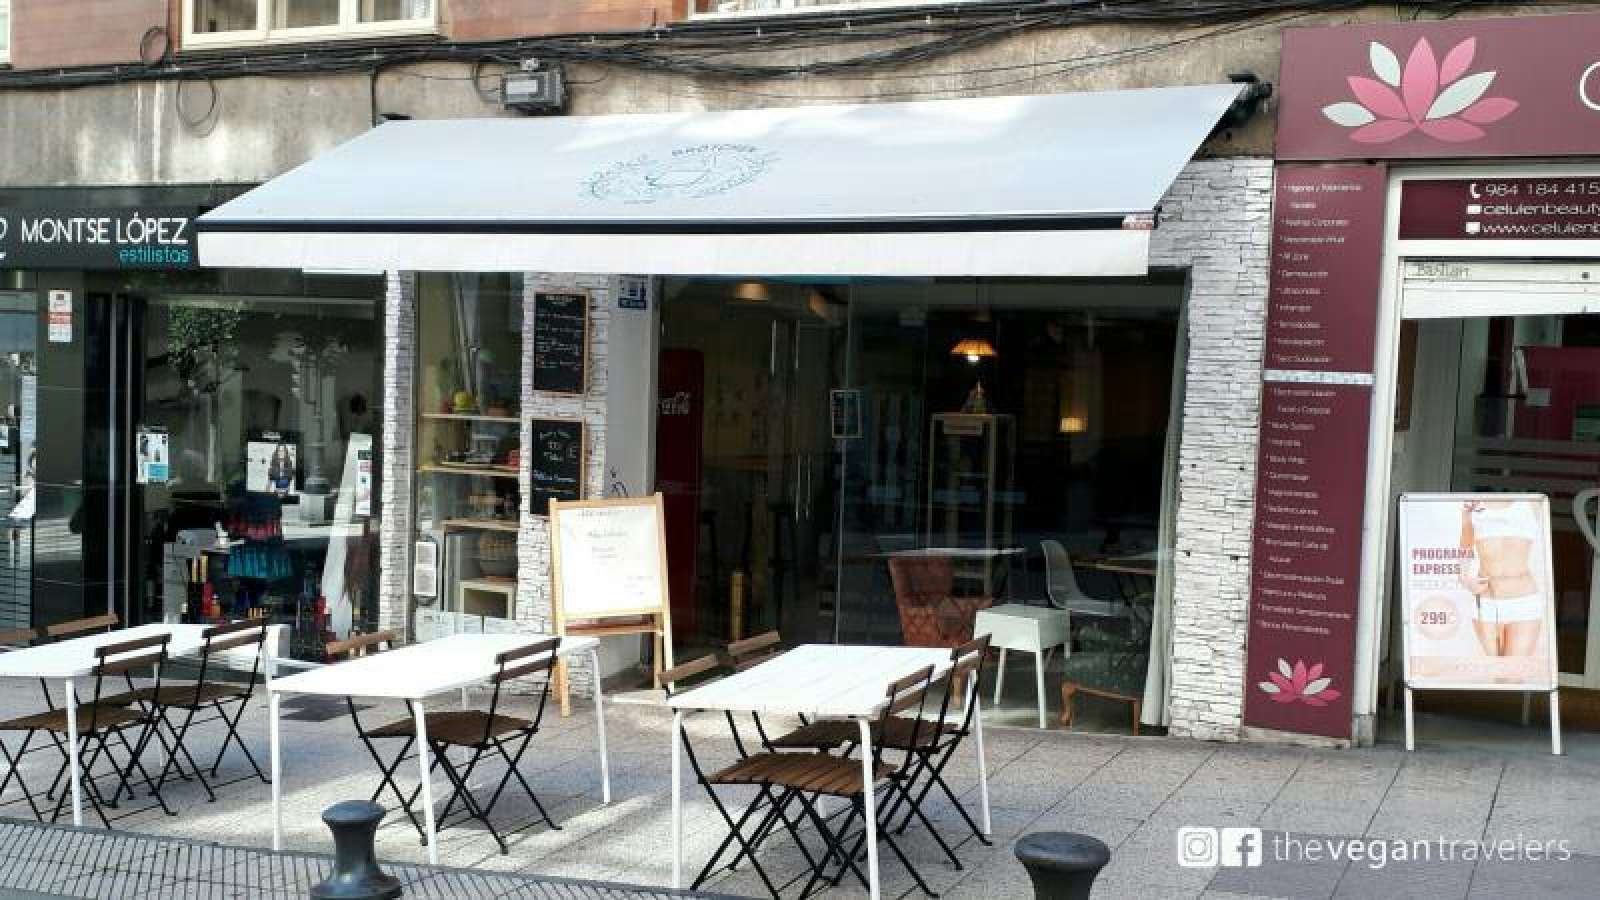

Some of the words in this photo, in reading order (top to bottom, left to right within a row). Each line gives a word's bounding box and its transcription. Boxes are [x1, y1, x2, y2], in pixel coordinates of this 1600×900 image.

[1485, 183, 1518, 195] 984
[1528, 183, 1559, 195] 184
[1564, 182, 1600, 195] 415
[21, 217, 111, 244] MONTSE
[116, 211, 189, 244] LÓPEZ
[119, 246, 189, 263] estilistas
[1412, 548, 1475, 560] PROGRAMA
[1412, 563, 1461, 575] EXPRESS
